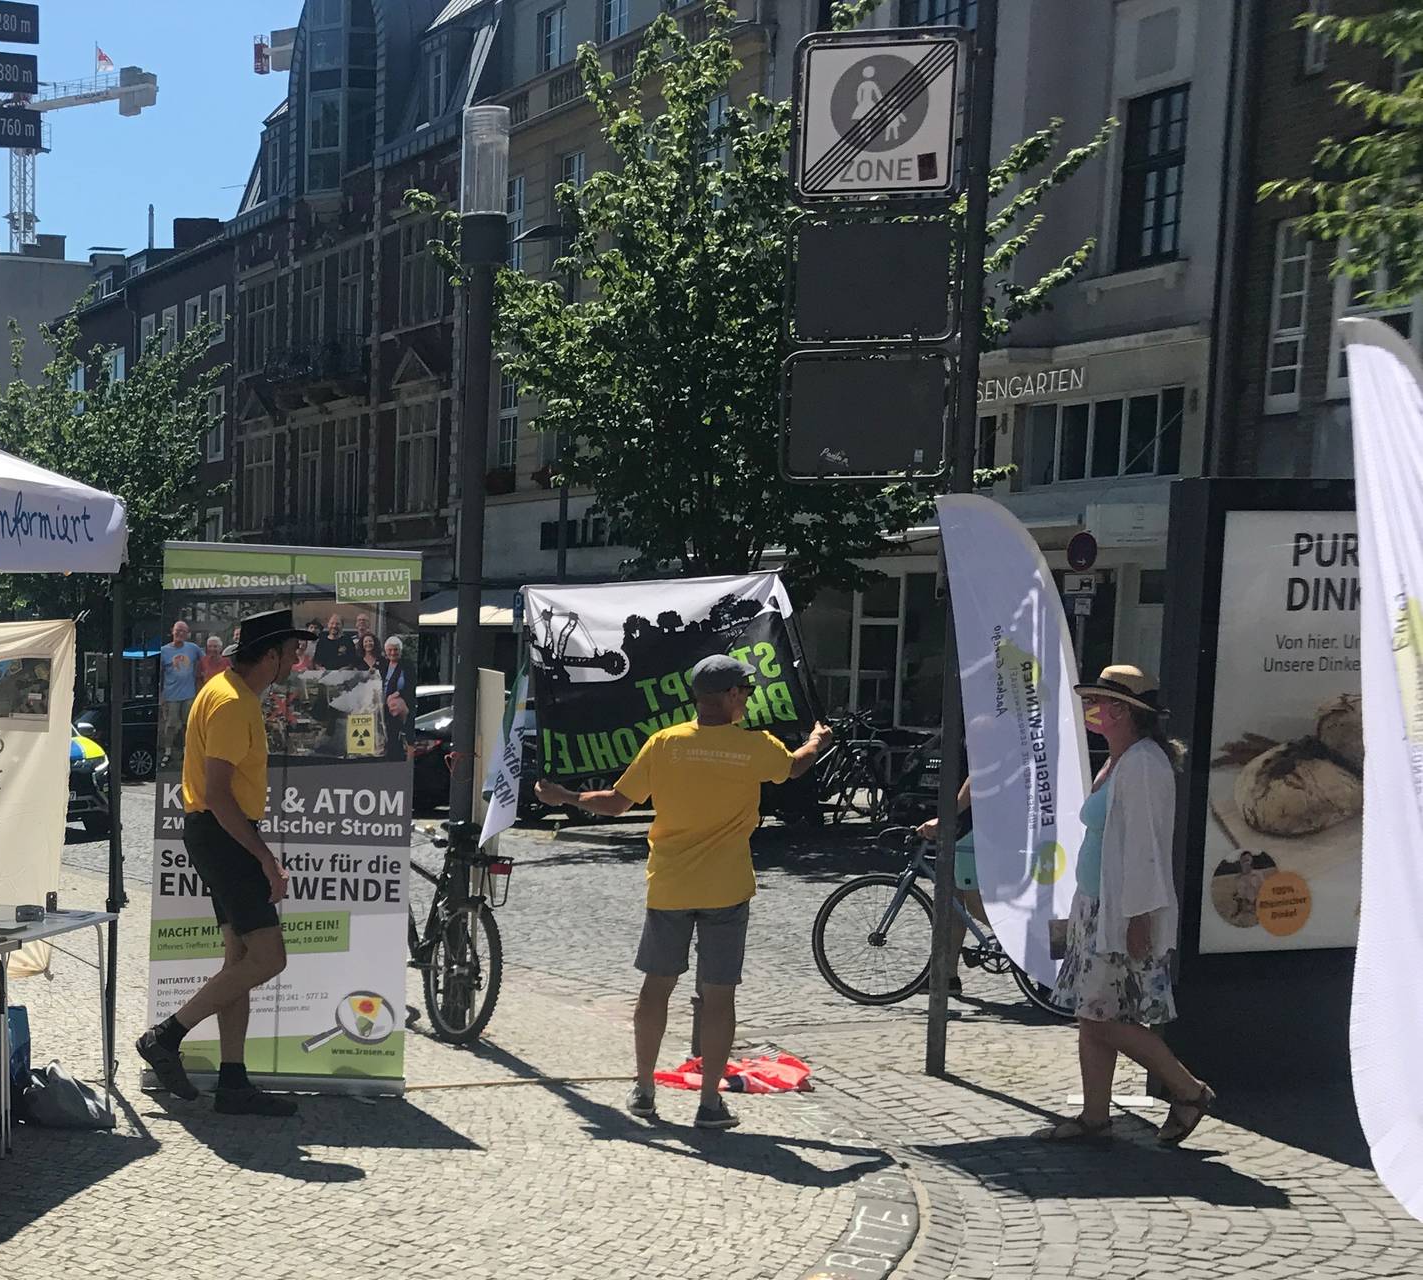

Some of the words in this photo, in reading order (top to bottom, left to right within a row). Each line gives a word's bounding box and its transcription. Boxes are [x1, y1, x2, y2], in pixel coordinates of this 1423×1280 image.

[20, 20, 31, 33] m
[22, 70, 33, 84] m
[0, 117, 22, 136] 760
[24, 123, 35, 137] m
[839, 157, 913, 182] ZONE
[977, 365, 1086, 402] SENGARTEN
[1292, 532, 1360, 568] PUR
[171, 573, 307, 589] www.3rosen.eu
[336, 570, 410, 583] INITIATIVE
[339, 587, 347, 597] 3
[348, 586, 385, 597] Rosen
[385, 585, 408, 596] e.V.
[1286, 577, 1362, 612] DINK
[1275, 633, 1303, 650] Von
[1307, 632, 1339, 650] hier.
[1264, 656, 1315, 673] Unsere
[1318, 655, 1361, 673] Dinke
[281, 786, 305, 813] &
[313, 788, 404, 816] ATOM
[258, 816, 334, 836] alscher
[340, 817, 403, 837] Strom
[281, 852, 324, 872] ktiv
[329, 853, 361, 874] für
[367, 855, 401, 875] die
[157, 926, 198, 938] MACHT
[201, 925, 221, 936] MIT
[281, 921, 312, 932] EUCH
[315, 920, 339, 930] EIN!
[157, 976, 195, 985] INITIATIVE
